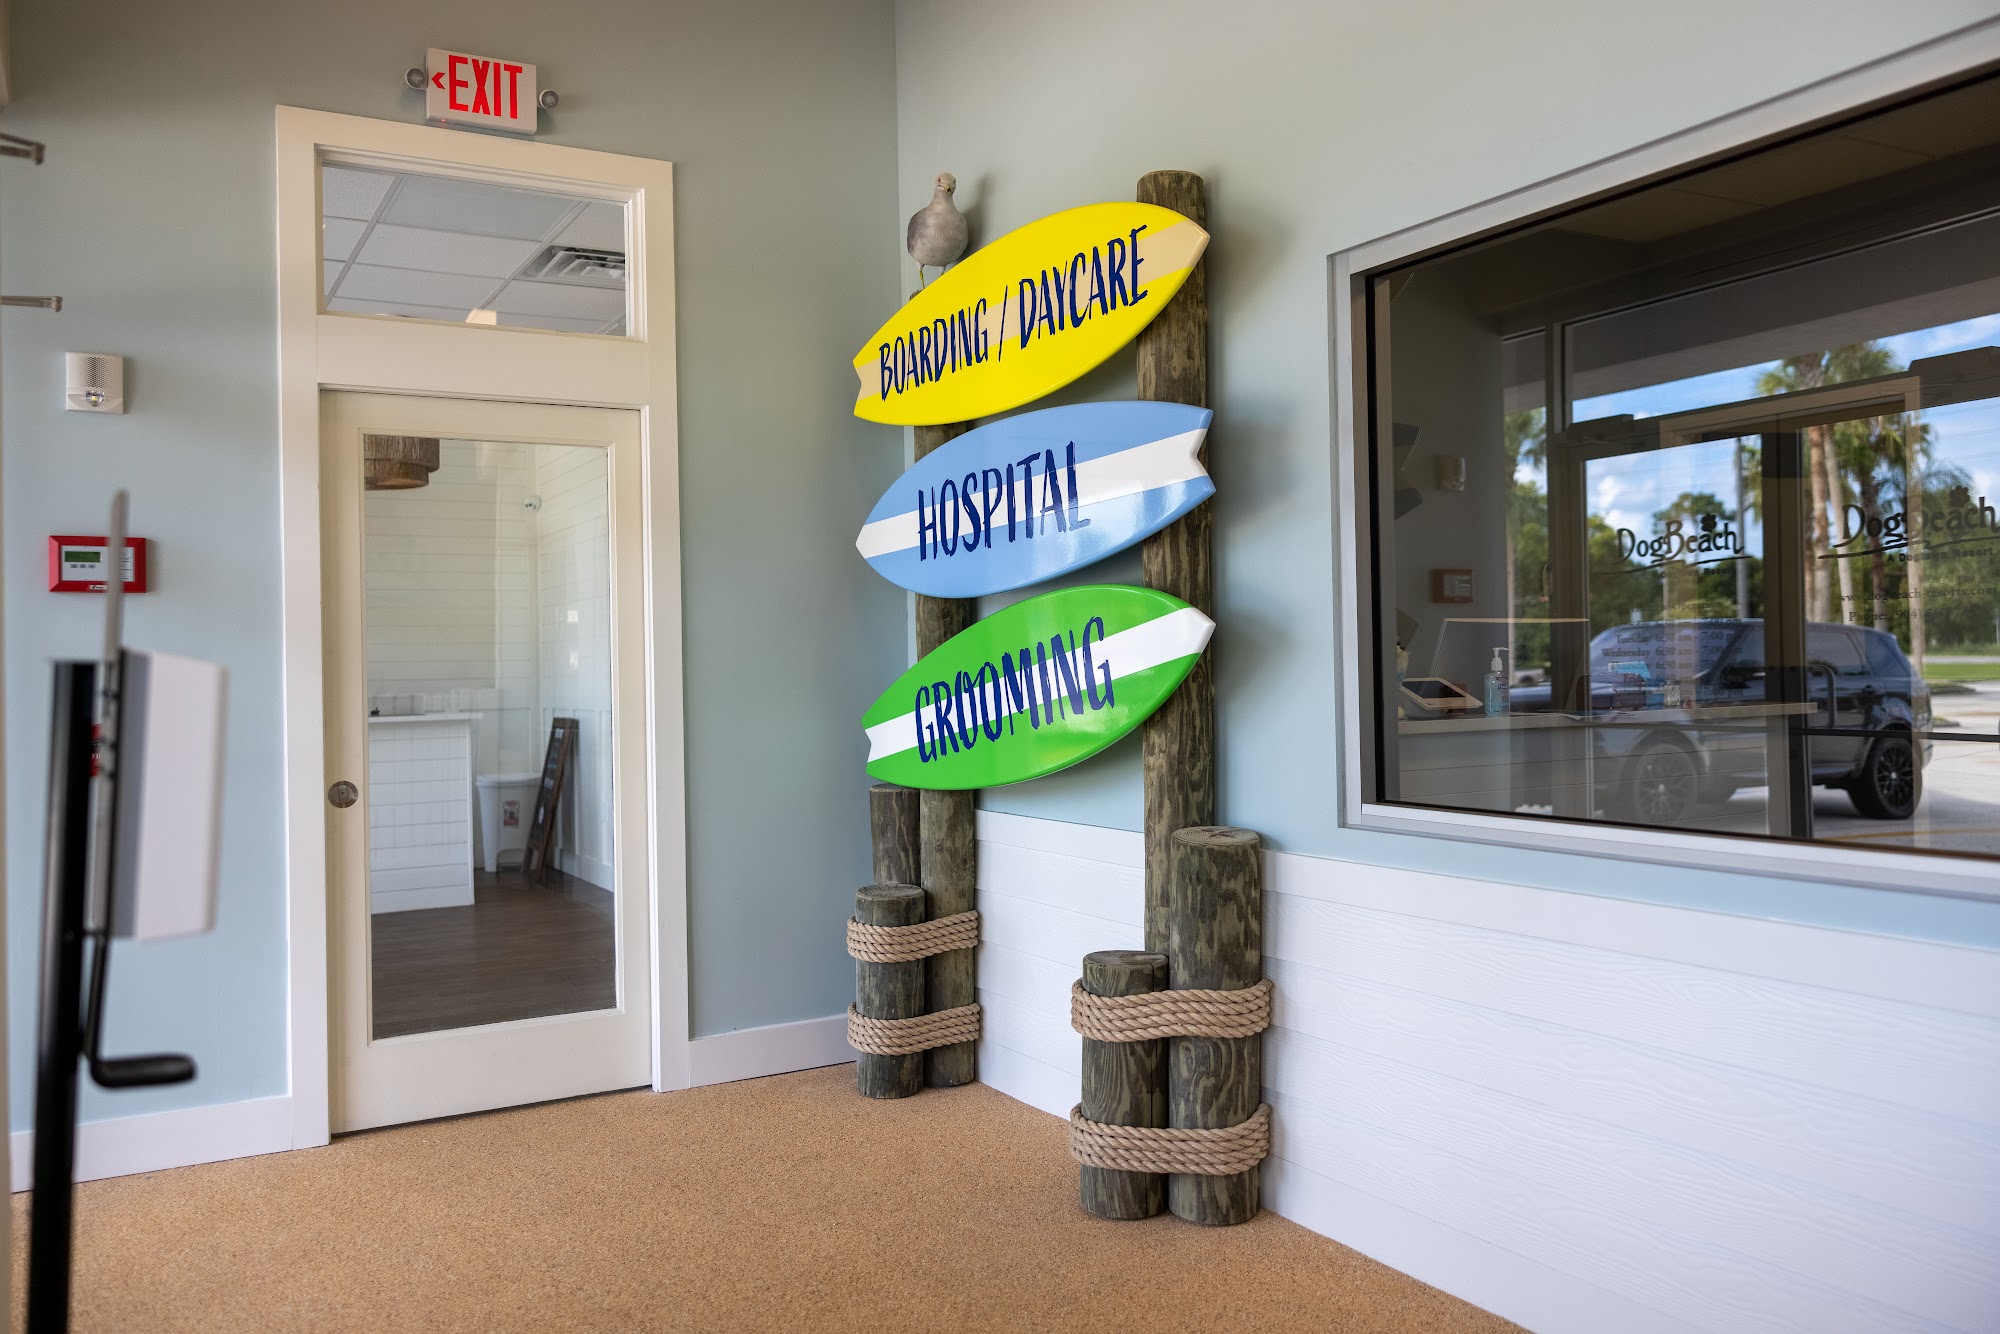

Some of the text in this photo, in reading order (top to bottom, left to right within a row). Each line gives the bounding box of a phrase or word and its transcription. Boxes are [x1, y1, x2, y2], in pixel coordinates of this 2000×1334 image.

[449, 54, 523, 119] EXIT
[879, 297, 988, 402] BOARDING
[1018, 224, 1149, 350] DAYCARE
[917, 440, 1091, 562] HOSPITAL
[1611, 520, 1745, 565] DogBeach
[1601, 647, 1650, 659] Wednesday
[1655, 646, 1675, 657] 6:30
[1615, 634, 1649, 646] Tuesday
[915, 616, 1115, 763] GROOMING
